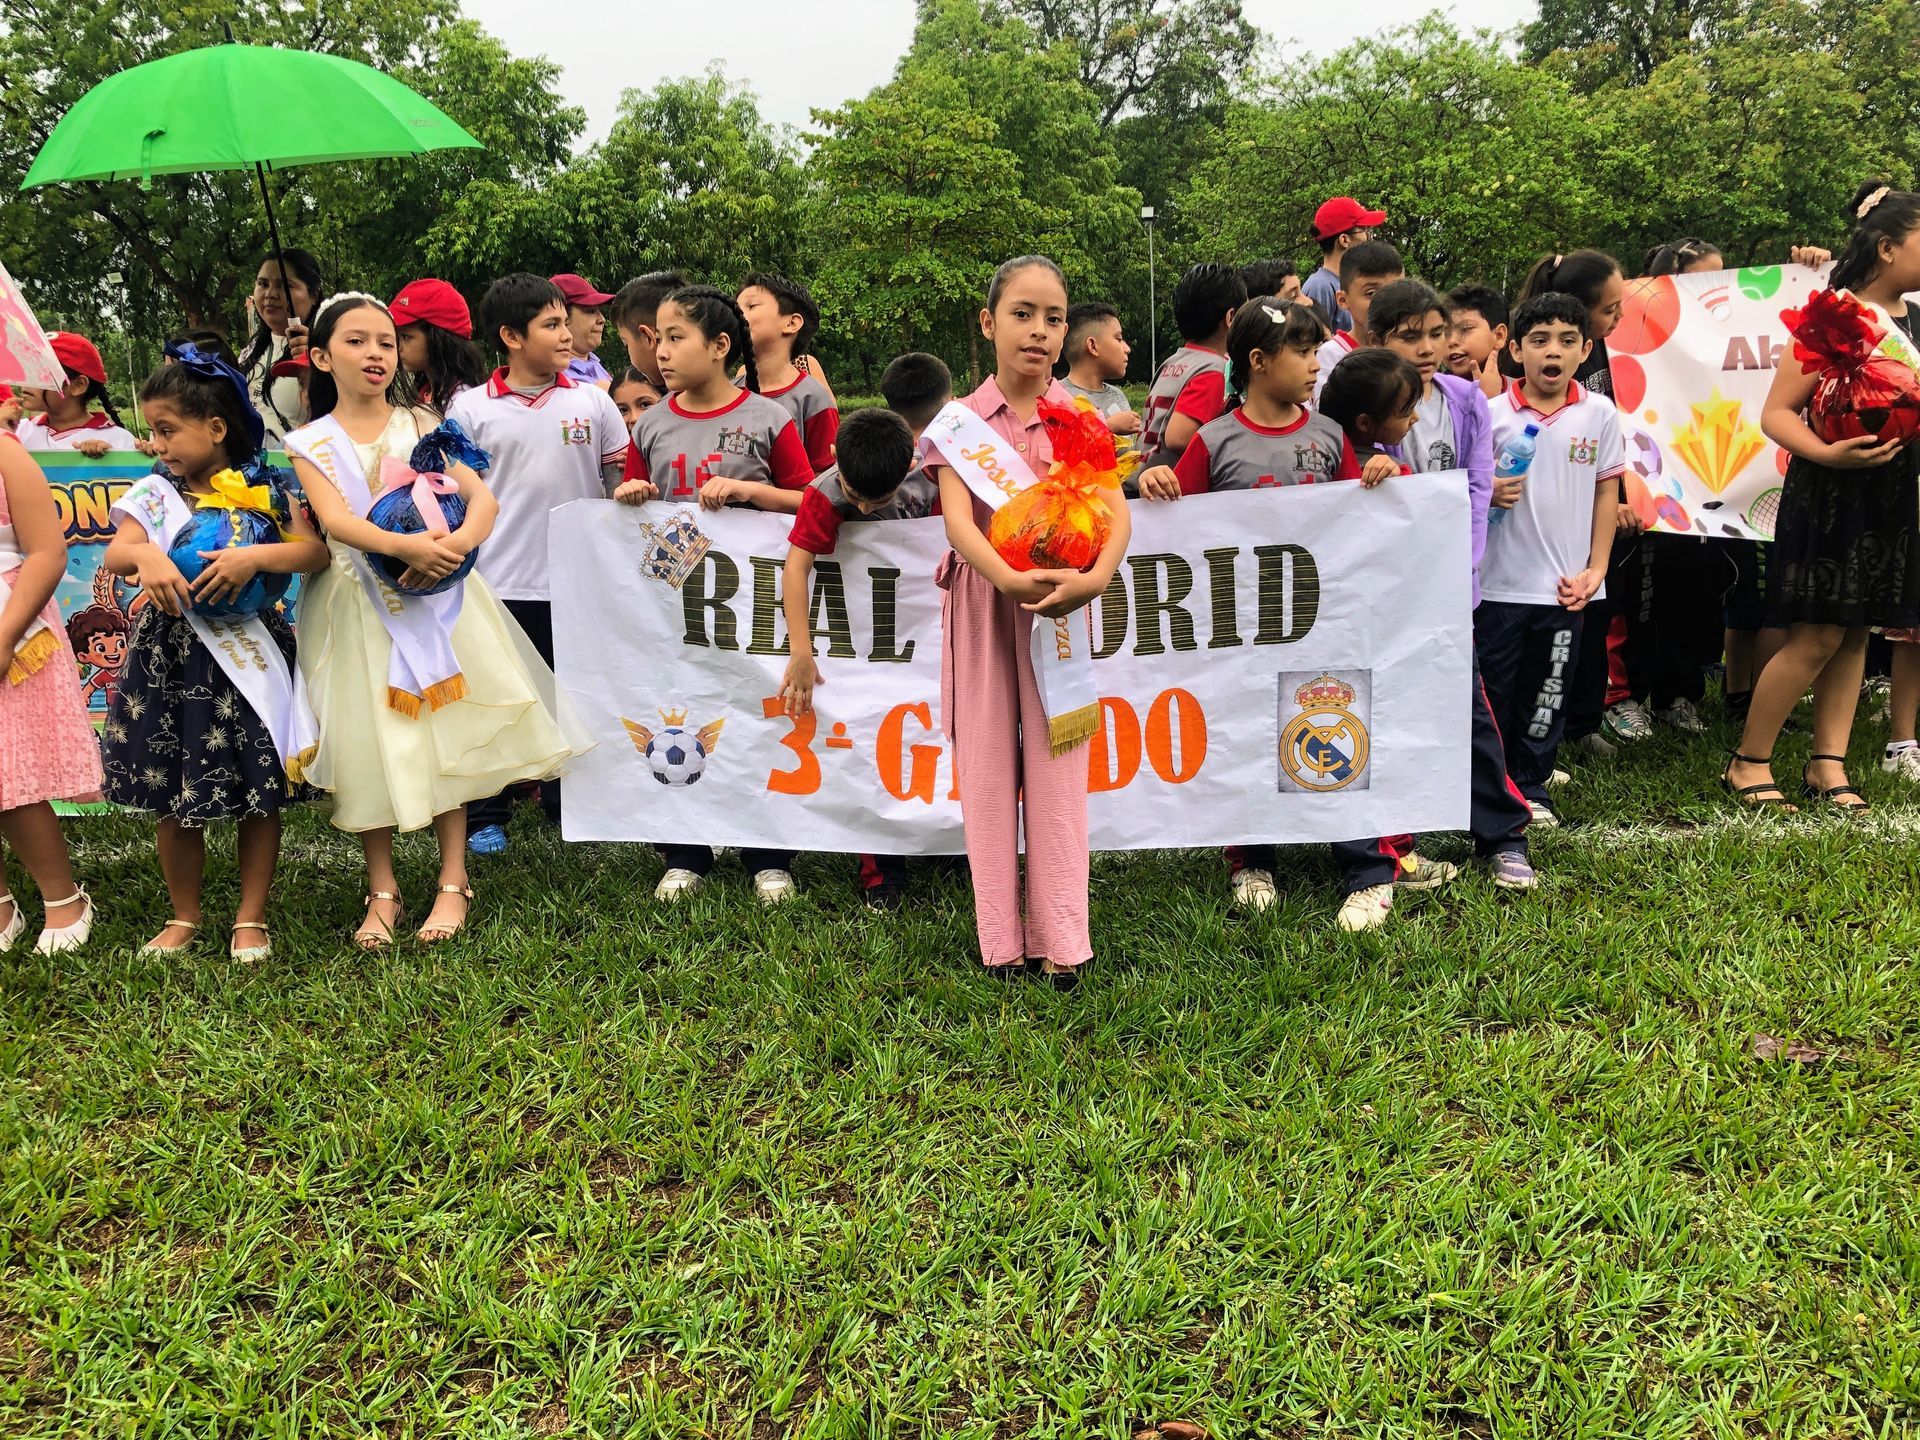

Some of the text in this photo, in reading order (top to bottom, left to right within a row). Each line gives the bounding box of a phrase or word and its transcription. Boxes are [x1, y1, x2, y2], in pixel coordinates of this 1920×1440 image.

[682, 543, 1320, 663] REAL DRID
[1527, 629, 1573, 740] CRISMAG
[875, 687, 1207, 805] GDO
